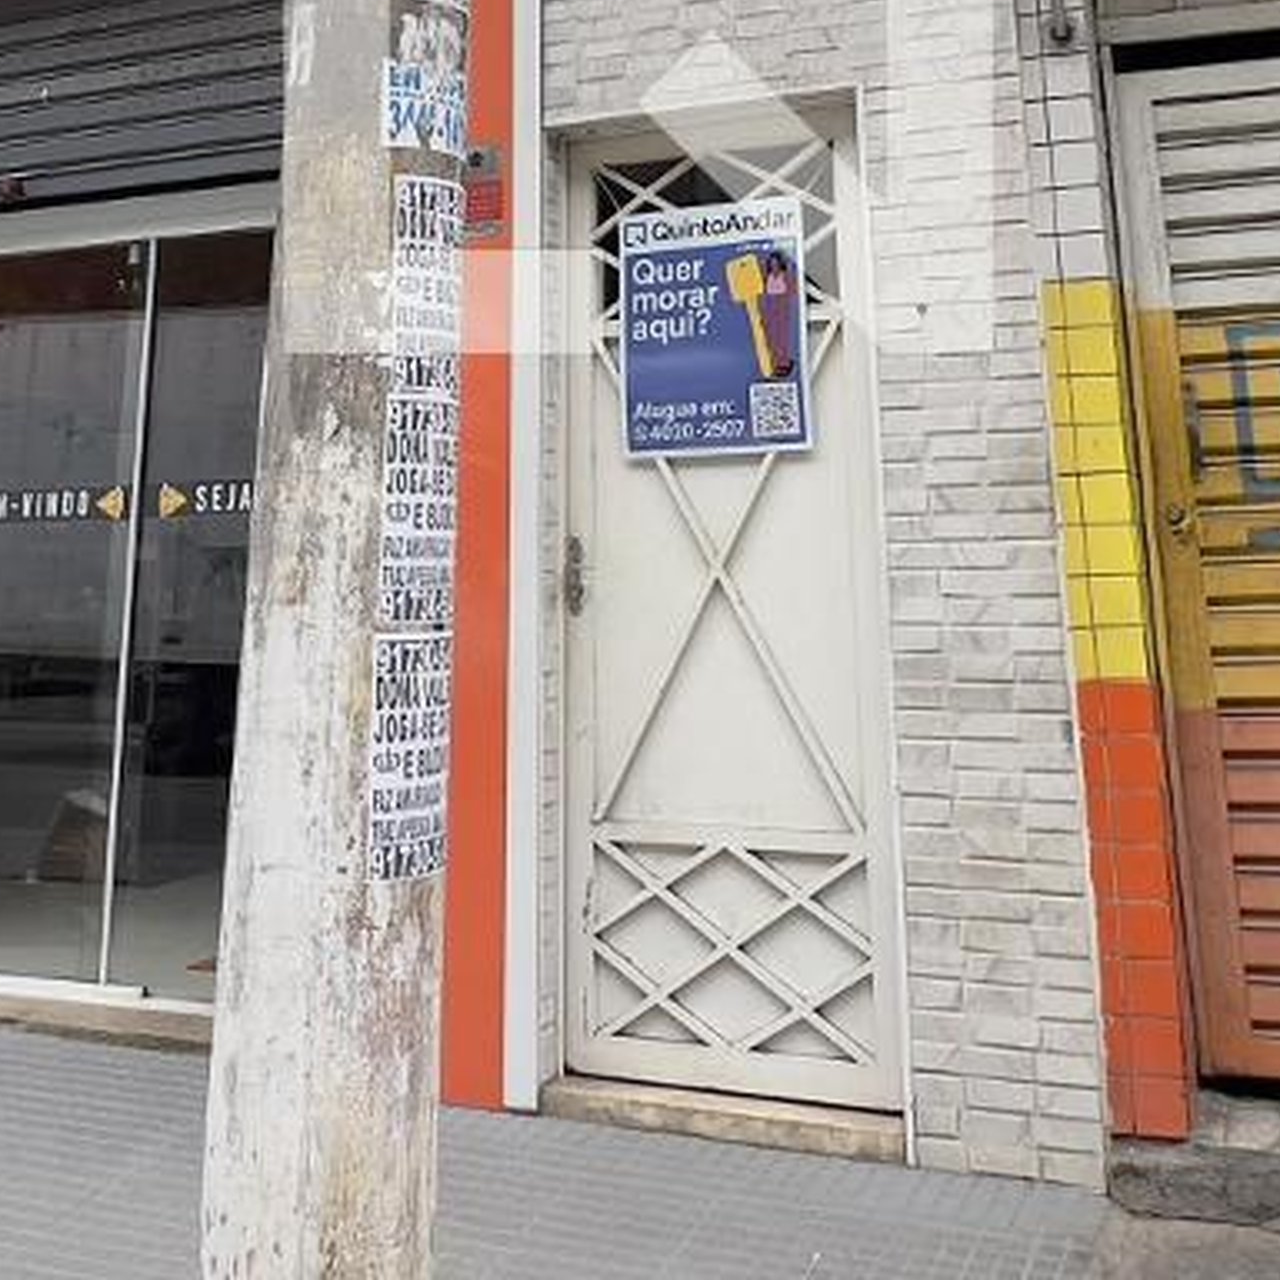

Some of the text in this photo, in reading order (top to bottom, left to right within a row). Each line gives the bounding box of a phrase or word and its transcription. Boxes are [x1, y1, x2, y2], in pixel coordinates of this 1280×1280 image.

[651, 208, 794, 242] QuintoAndar
[632, 257, 705, 286] Quer
[631, 285, 719, 315] morar
[631, 308, 713, 346] aqui?
[195, 483, 254, 514] SEJA
